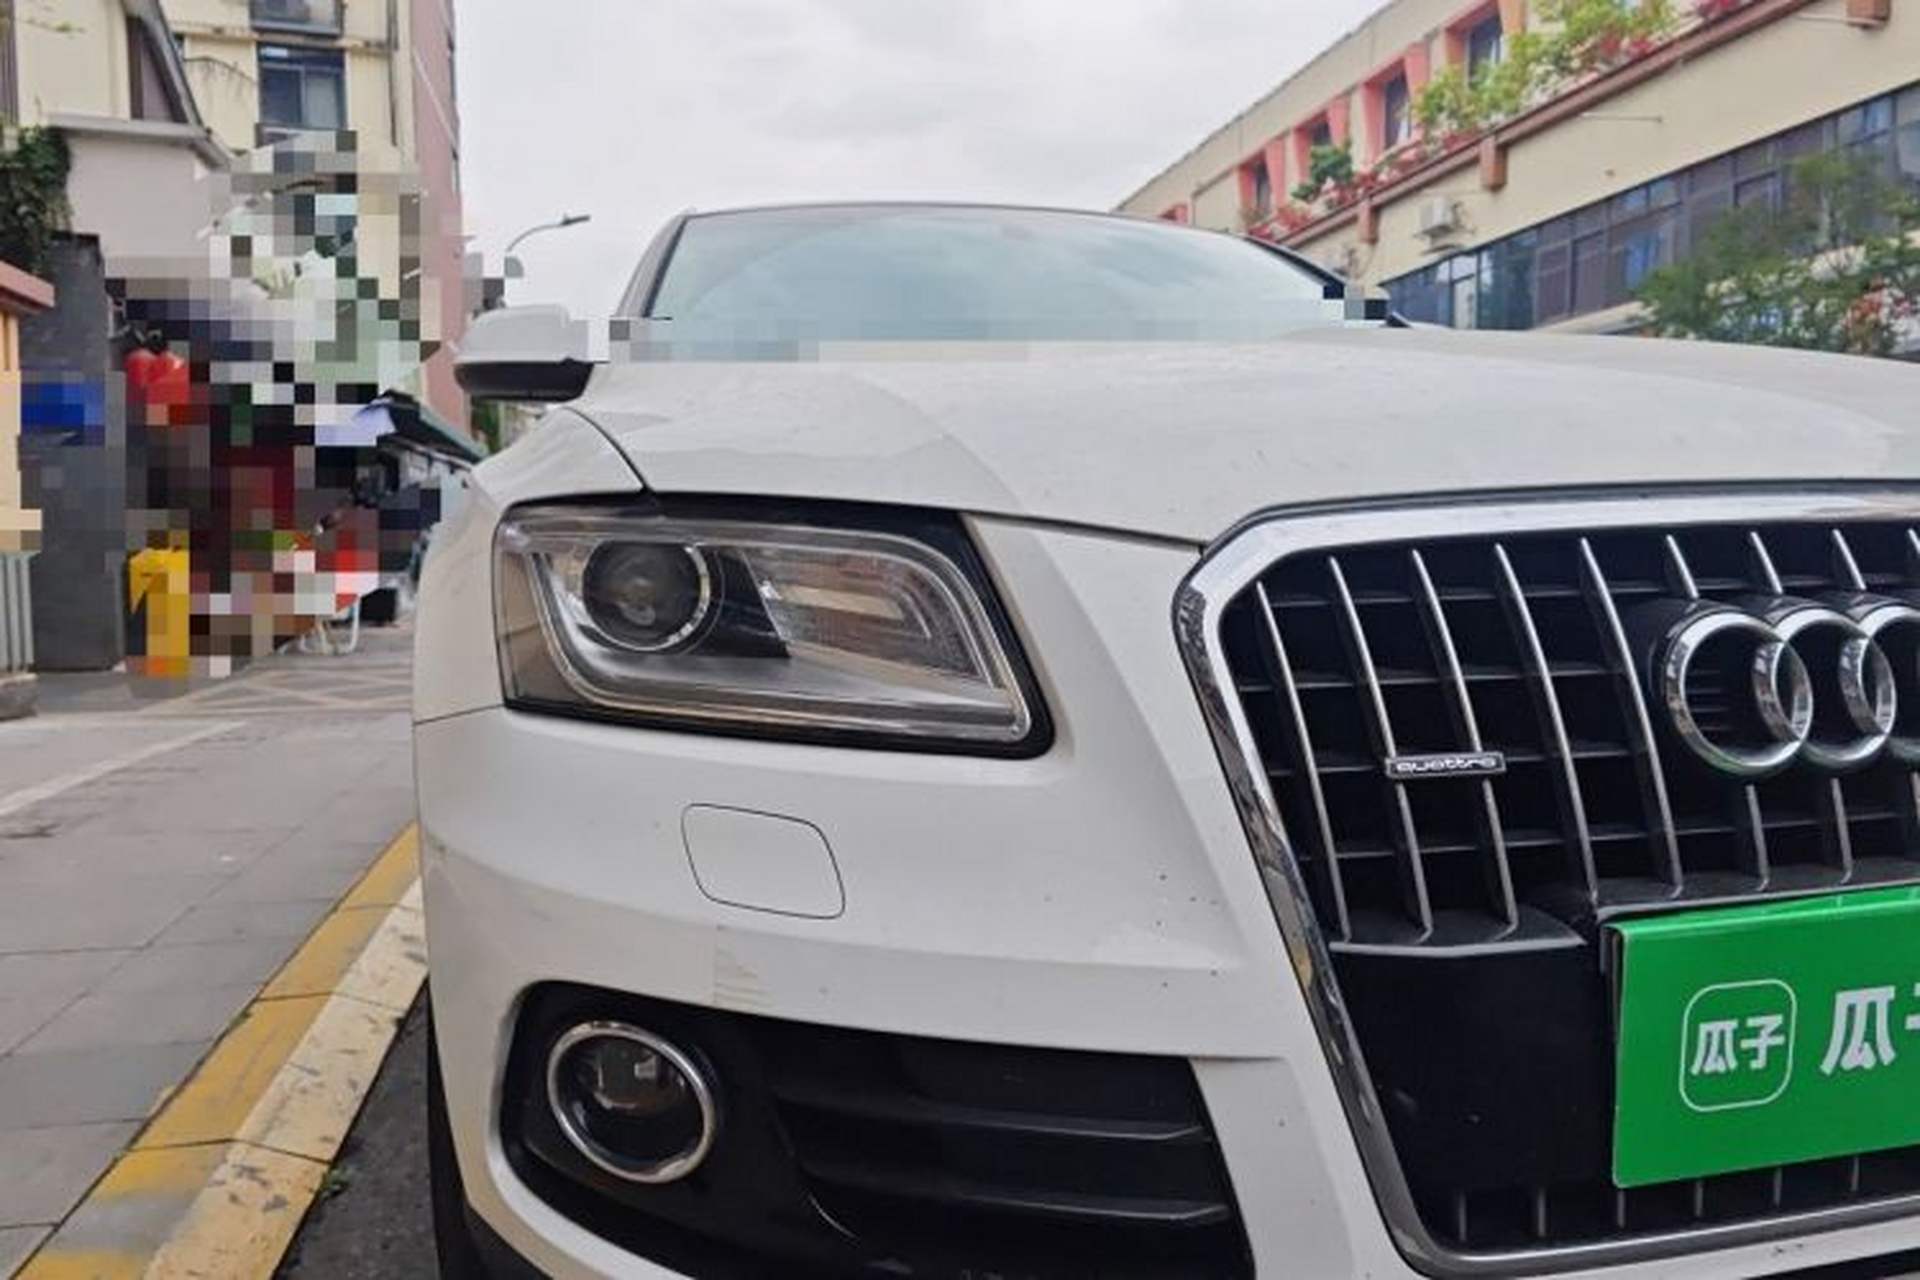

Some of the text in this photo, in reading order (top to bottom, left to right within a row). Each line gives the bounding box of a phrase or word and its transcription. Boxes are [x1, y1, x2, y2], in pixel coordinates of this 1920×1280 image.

[1396, 758, 1497, 774] quattro
[1690, 983, 1920, 1076] 瓜子 瓜
